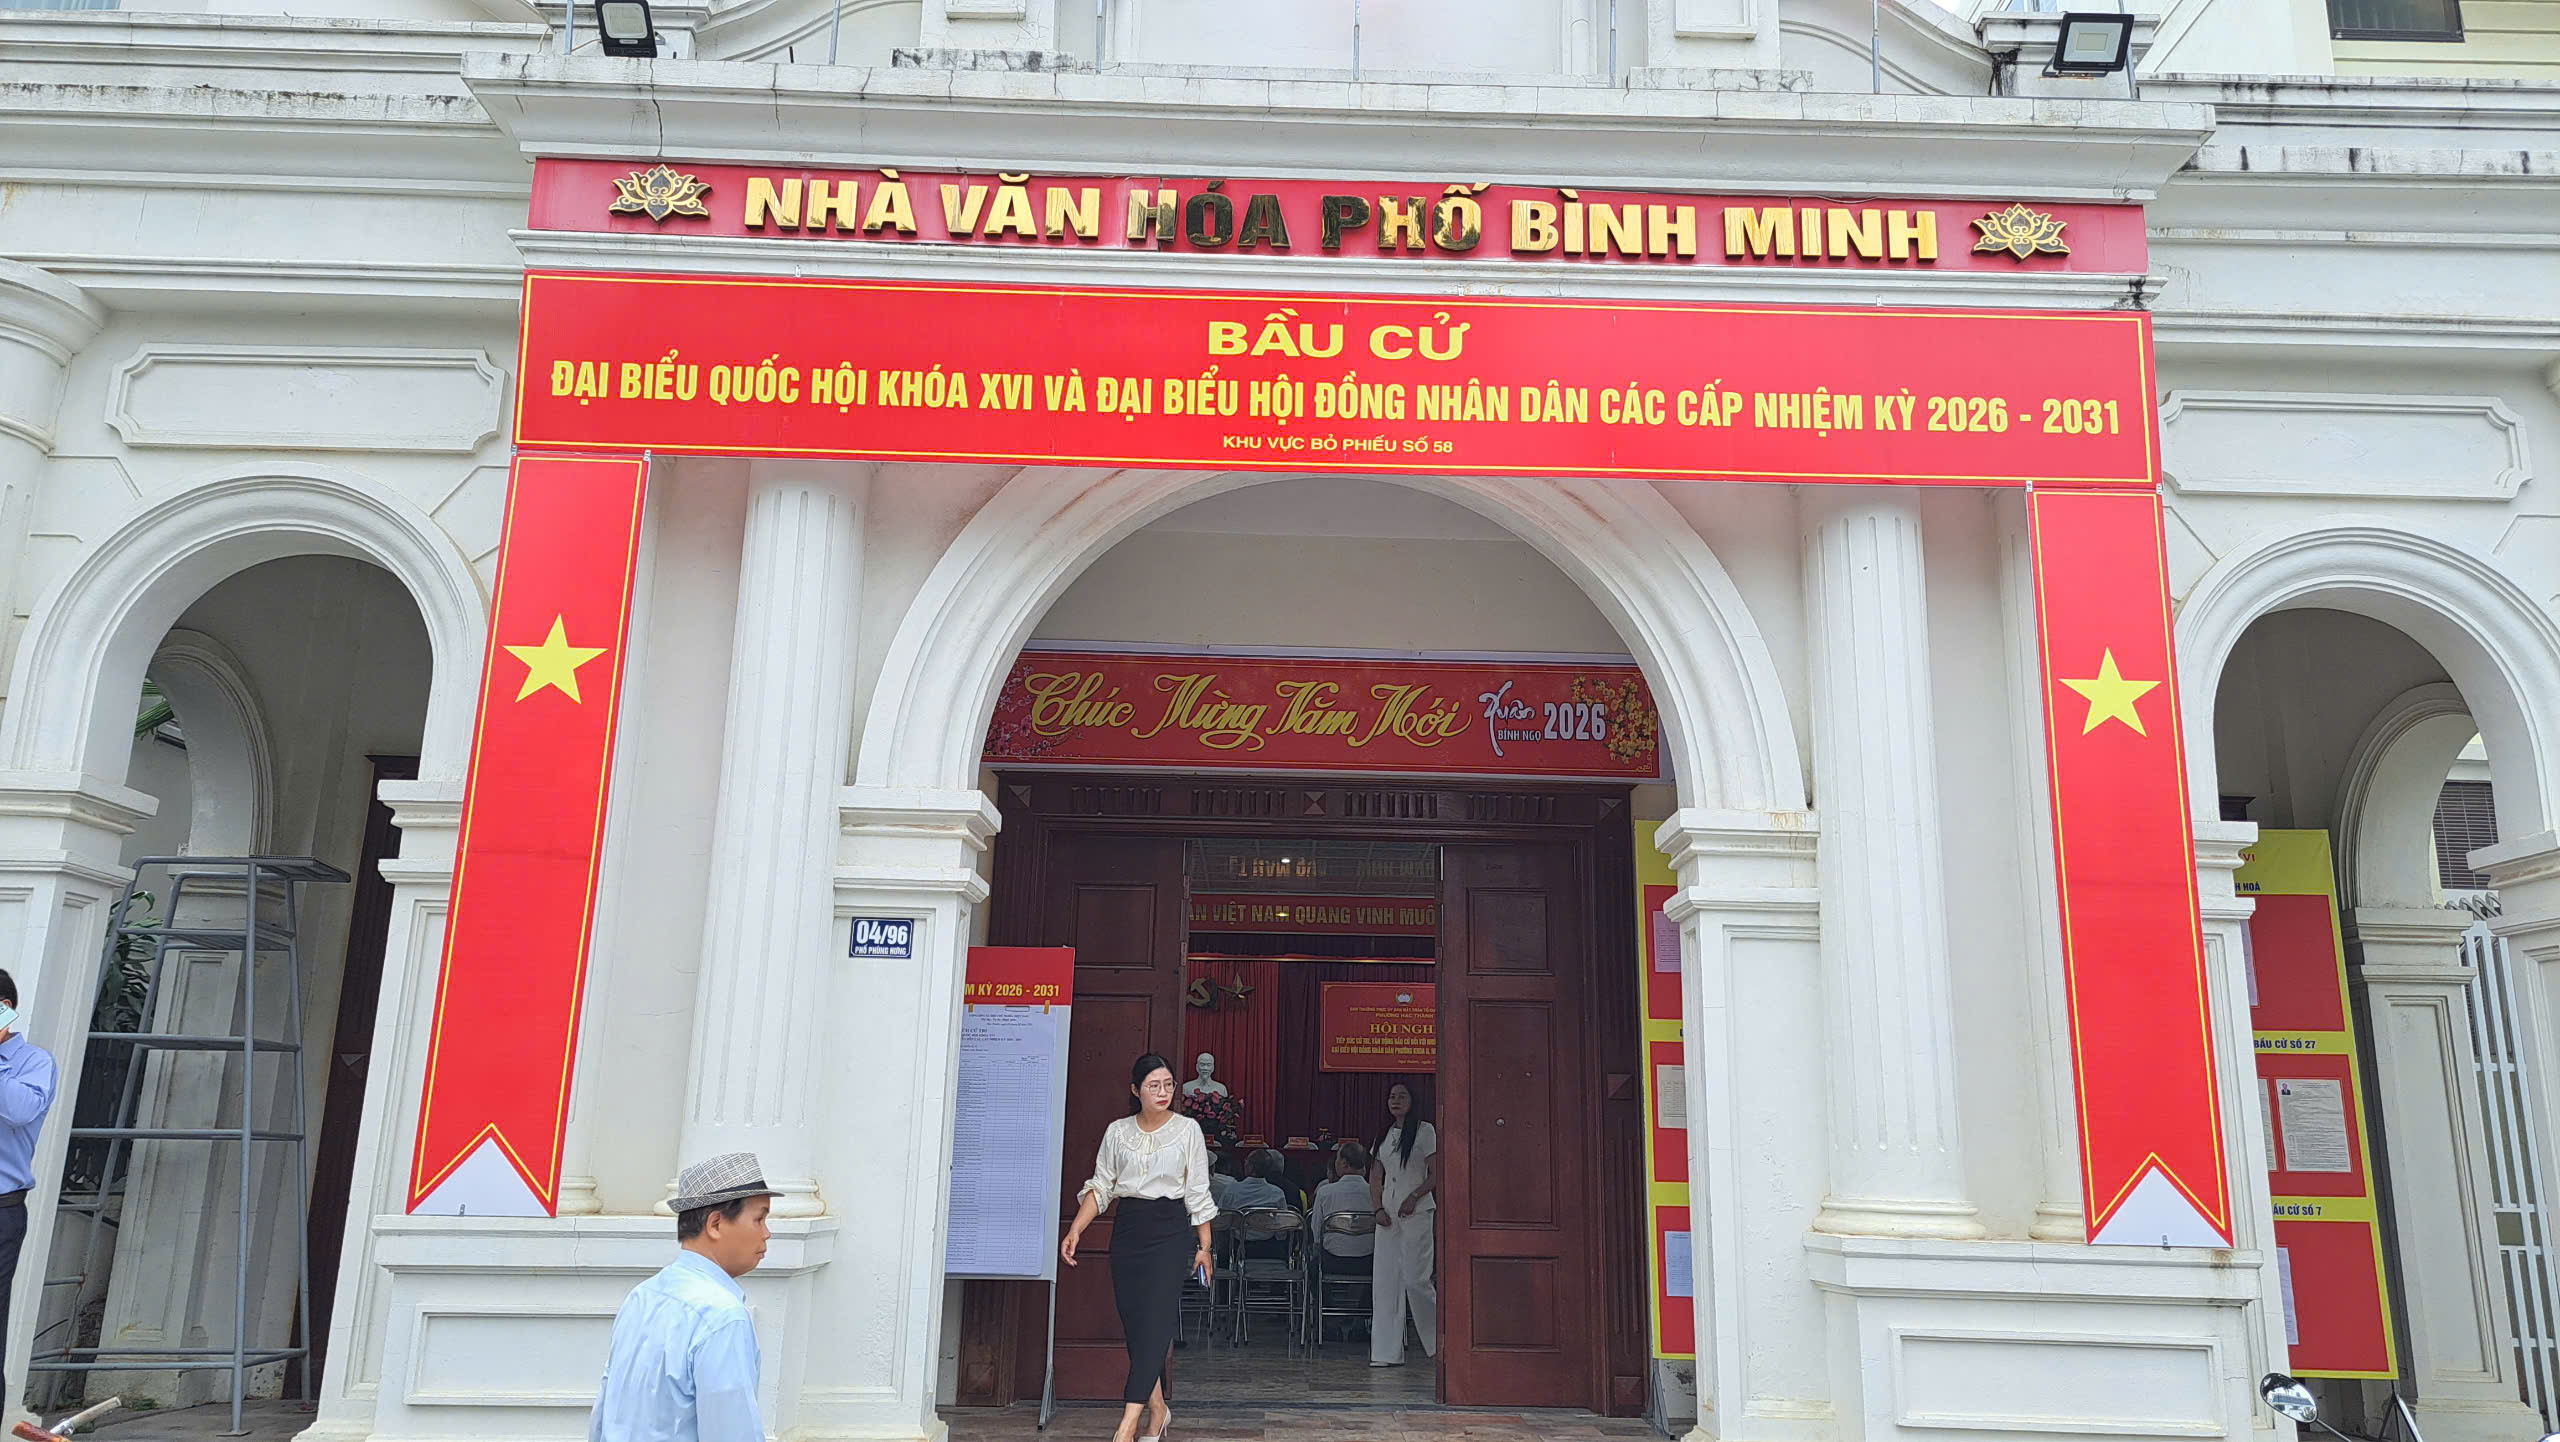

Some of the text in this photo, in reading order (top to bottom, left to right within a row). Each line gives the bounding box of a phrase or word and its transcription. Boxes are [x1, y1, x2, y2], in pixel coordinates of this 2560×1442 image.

[744, 168, 1938, 261] NHÀ VĂN HÓA PHỐ BÌNH MINH
[1208, 308, 1471, 361] BẦU CỬ
[552, 349, 2119, 437] ĐẠI BIỂU QUỐC HỘI KHÓA XVI VÀ ĐẠI BIỂU HỘI ĐỒNG NHÂN DÂN CÁC CẤP NHIỆM KỲ 2026 - 2031
[1223, 434, 1453, 453] KHU VỰC BỎ PHIẾU SỐ 58
[1024, 671, 1473, 751] Chúc Mừng Năm Mới
[1478, 680, 1536, 757] Xuân
[1543, 702, 1607, 741] 2026
[2240, 853, 2256, 862] VI
[1213, 900, 1247, 925] VIỆT
[1251, 905, 1290, 923] NAM
[1295, 905, 1351, 926] QUANG
[1356, 907, 1394, 925] VINH
[1400, 904, 1435, 926] MUÔ
[856, 920, 909, 945] 04/96
[854, 944, 868, 955] PHỐ
[995, 983, 1023, 997] 2026
[1033, 984, 1060, 997] 2031
[1370, 1022, 1434, 1036] HỘI NGH
[2290, 1037, 2302, 1049] SỐ
[2305, 1040, 2316, 1049] 27
[2302, 1203, 2314, 1216] SỐ
[2316, 1206, 2322, 1216] 7
